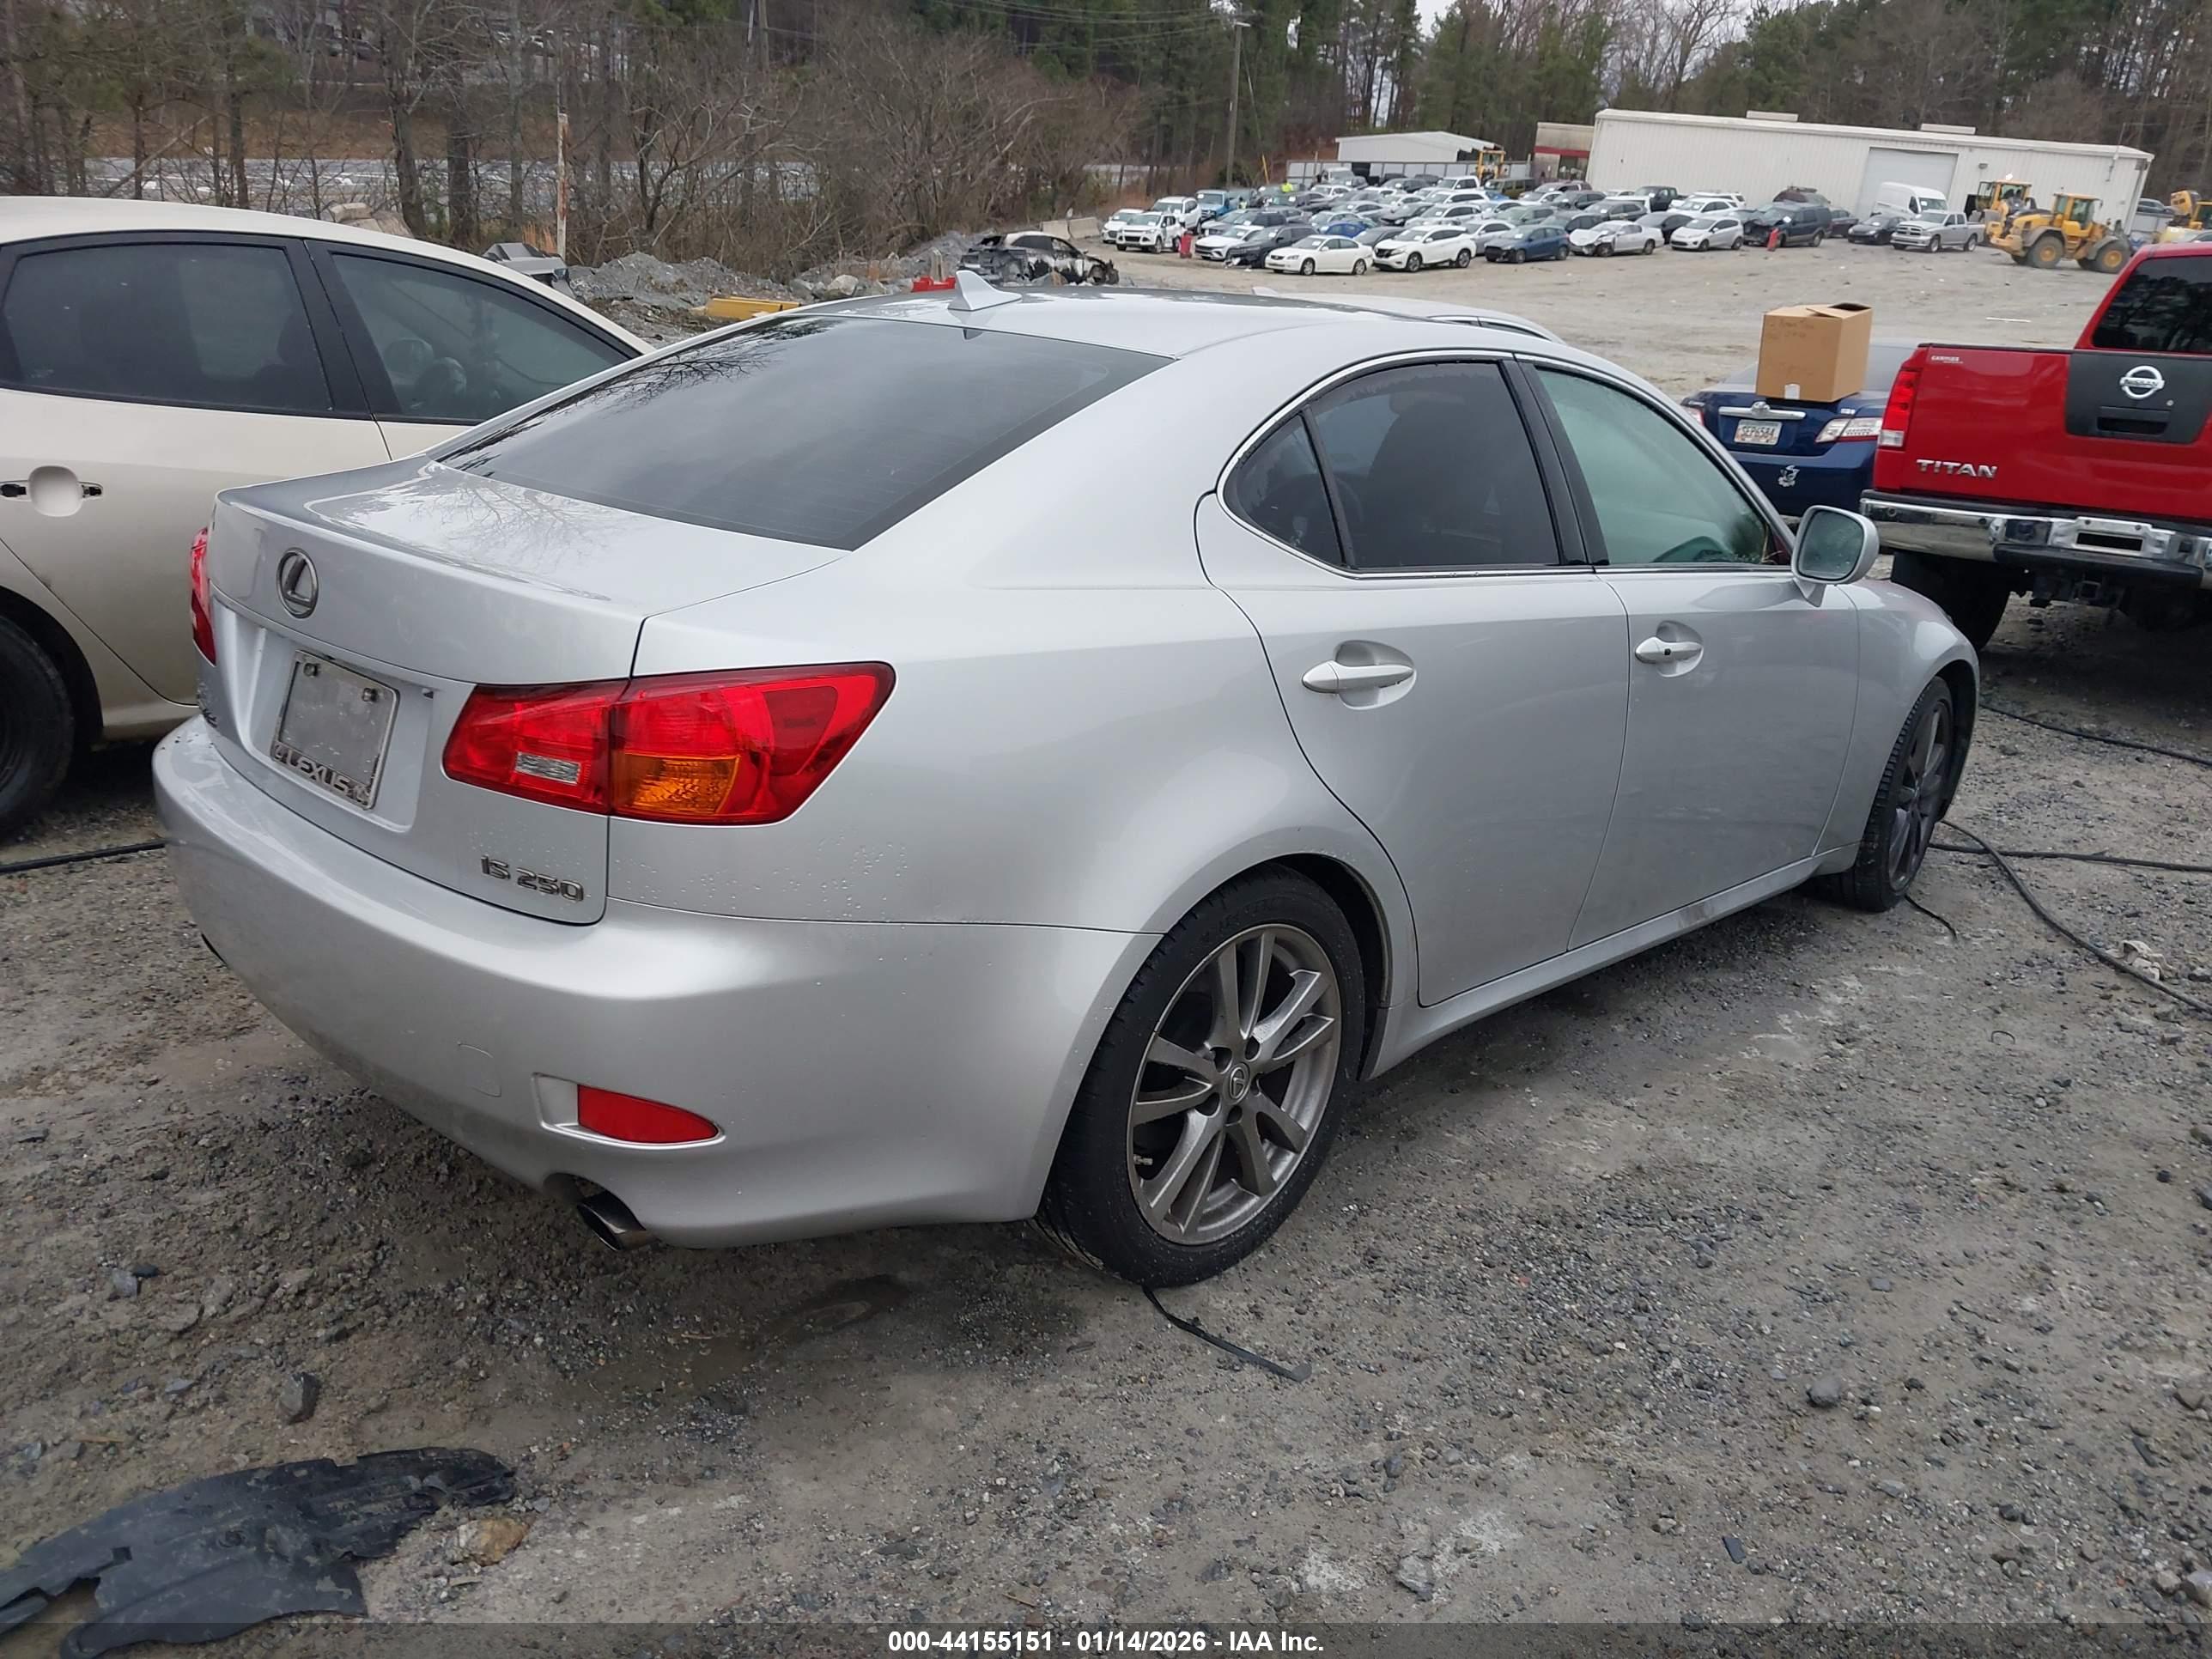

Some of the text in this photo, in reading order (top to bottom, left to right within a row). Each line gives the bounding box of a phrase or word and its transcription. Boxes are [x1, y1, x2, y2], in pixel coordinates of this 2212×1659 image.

[1916, 459, 1998, 478] TITAN
[286, 749, 350, 795] LEXUS
[481, 856, 584, 902] IS 250
